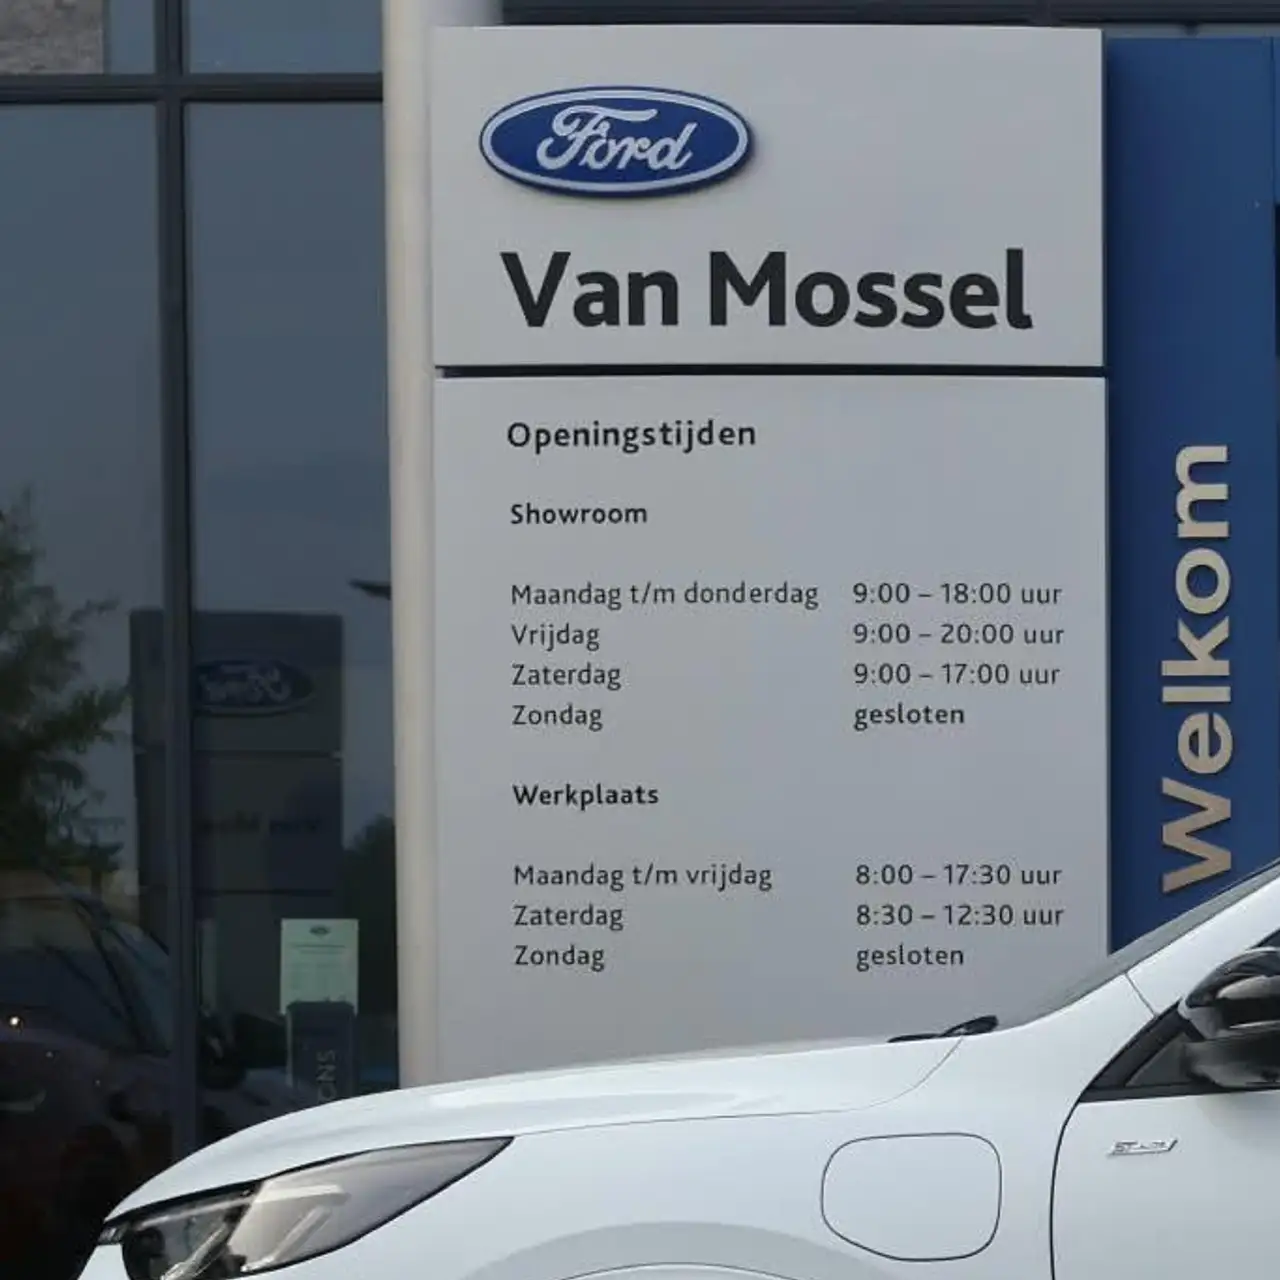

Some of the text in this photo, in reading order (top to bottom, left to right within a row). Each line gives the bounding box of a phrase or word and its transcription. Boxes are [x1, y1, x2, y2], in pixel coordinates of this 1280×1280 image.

[537, 105, 698, 171] Ford
[500, 248, 1033, 329] Van Mossel
[508, 420, 755, 455] Openingstijden
[511, 502, 647, 524] Showroom
[512, 581, 818, 611] Maandag t/m donderdag
[853, 583, 910, 604] 9:00
[941, 583, 1011, 604] 18:00
[1022, 588, 1062, 604] uur
[512, 623, 599, 652] Vrijdag
[854, 623, 910, 643] 9:00
[941, 623, 1013, 644] 20:00
[1024, 629, 1064, 644] uur
[512, 662, 621, 691] Zaterdag
[854, 663, 911, 685] 9:00
[942, 663, 1009, 684] 17:00
[1020, 669, 1060, 685] uur
[1161, 444, 1232, 893] Welkom
[512, 704, 603, 732] Zondag
[854, 702, 964, 731] gesloten
[513, 783, 658, 811] Werkplaats
[514, 863, 772, 892] Maandag t/m vrijdag
[856, 864, 913, 885] 8:00
[944, 864, 1010, 885] 17:30
[1021, 870, 1062, 885] uur
[514, 904, 623, 931] Zaterdag
[857, 904, 913, 926] 8:30
[944, 904, 1013, 925] 12:30
[1024, 909, 1064, 925] uur
[515, 944, 604, 972] Zondag
[856, 944, 963, 972] gesloten
